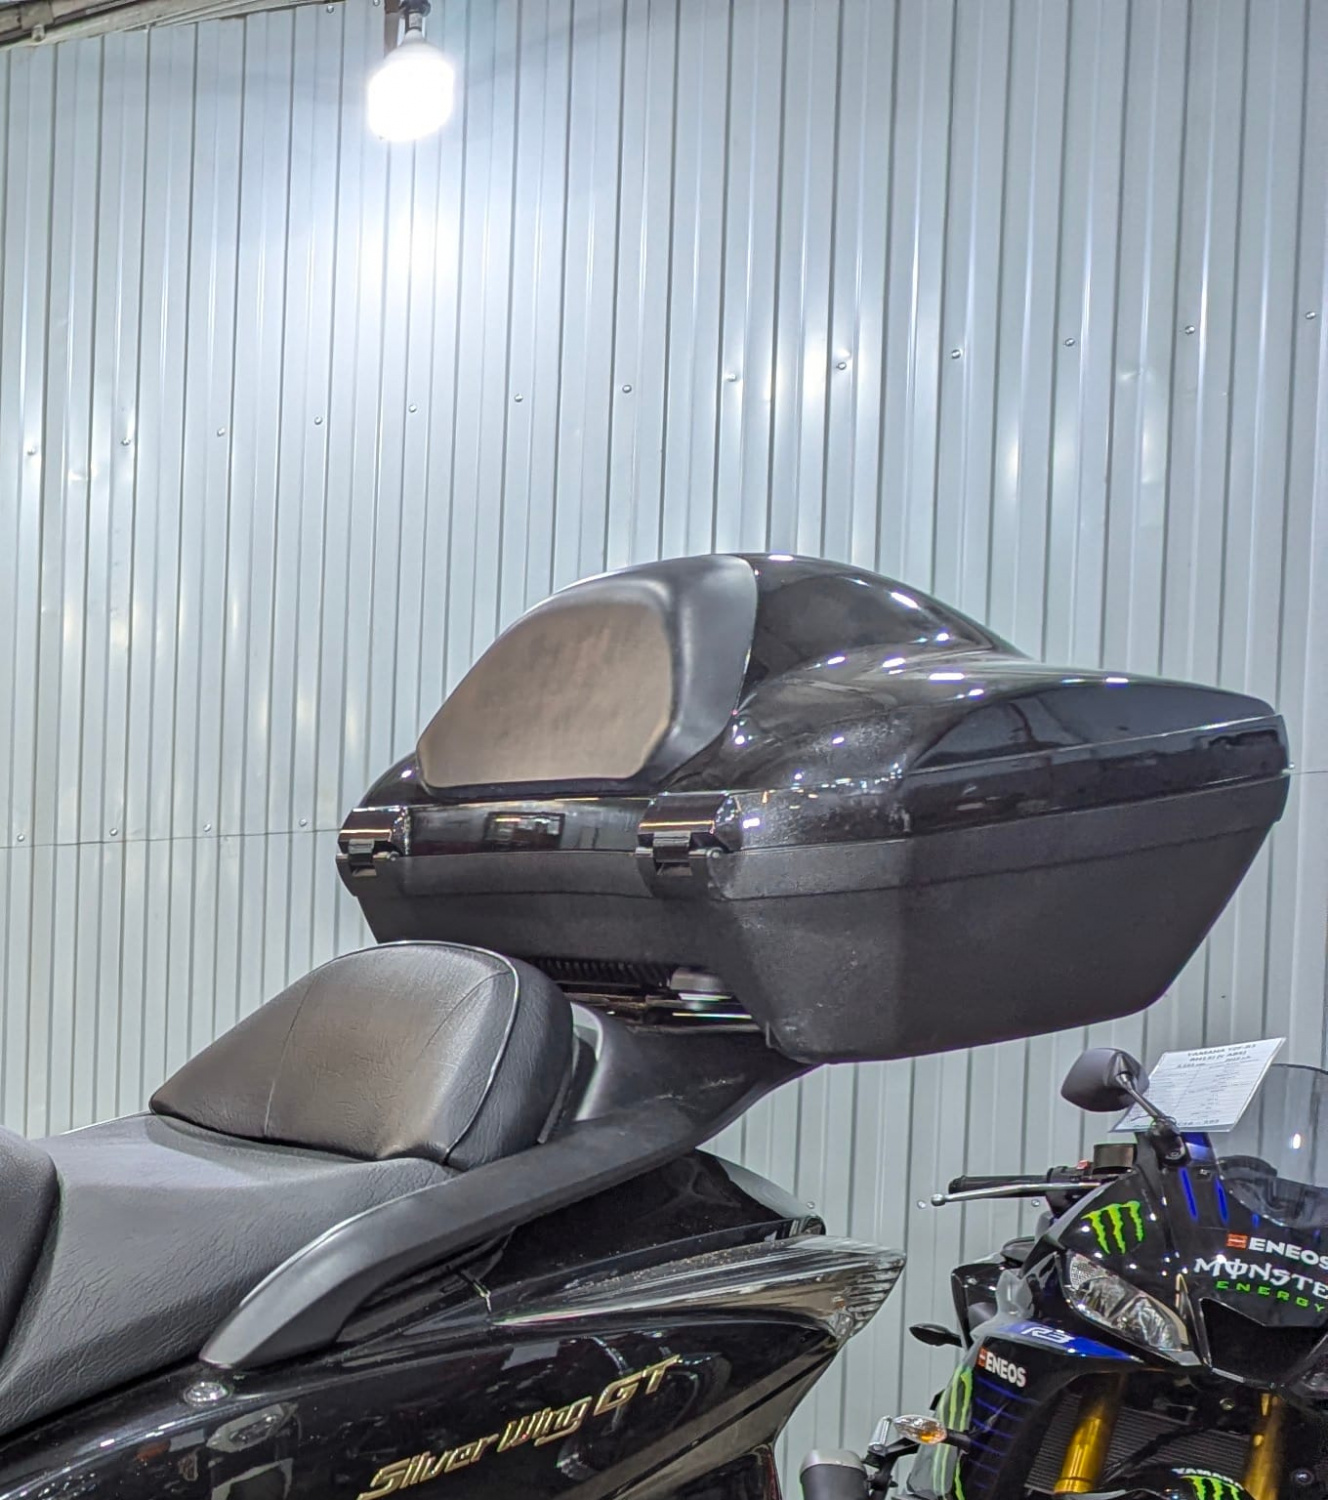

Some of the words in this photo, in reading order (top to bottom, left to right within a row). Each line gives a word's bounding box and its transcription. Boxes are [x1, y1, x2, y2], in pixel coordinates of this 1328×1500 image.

[1216, 1280, 1325, 1313] ENERGY
[1021, 1326, 1076, 1344] R3
[985, 1350, 1027, 1388] ENEOS
[497, 1396, 593, 1453] Wing
[594, 1354, 681, 1416] GT
